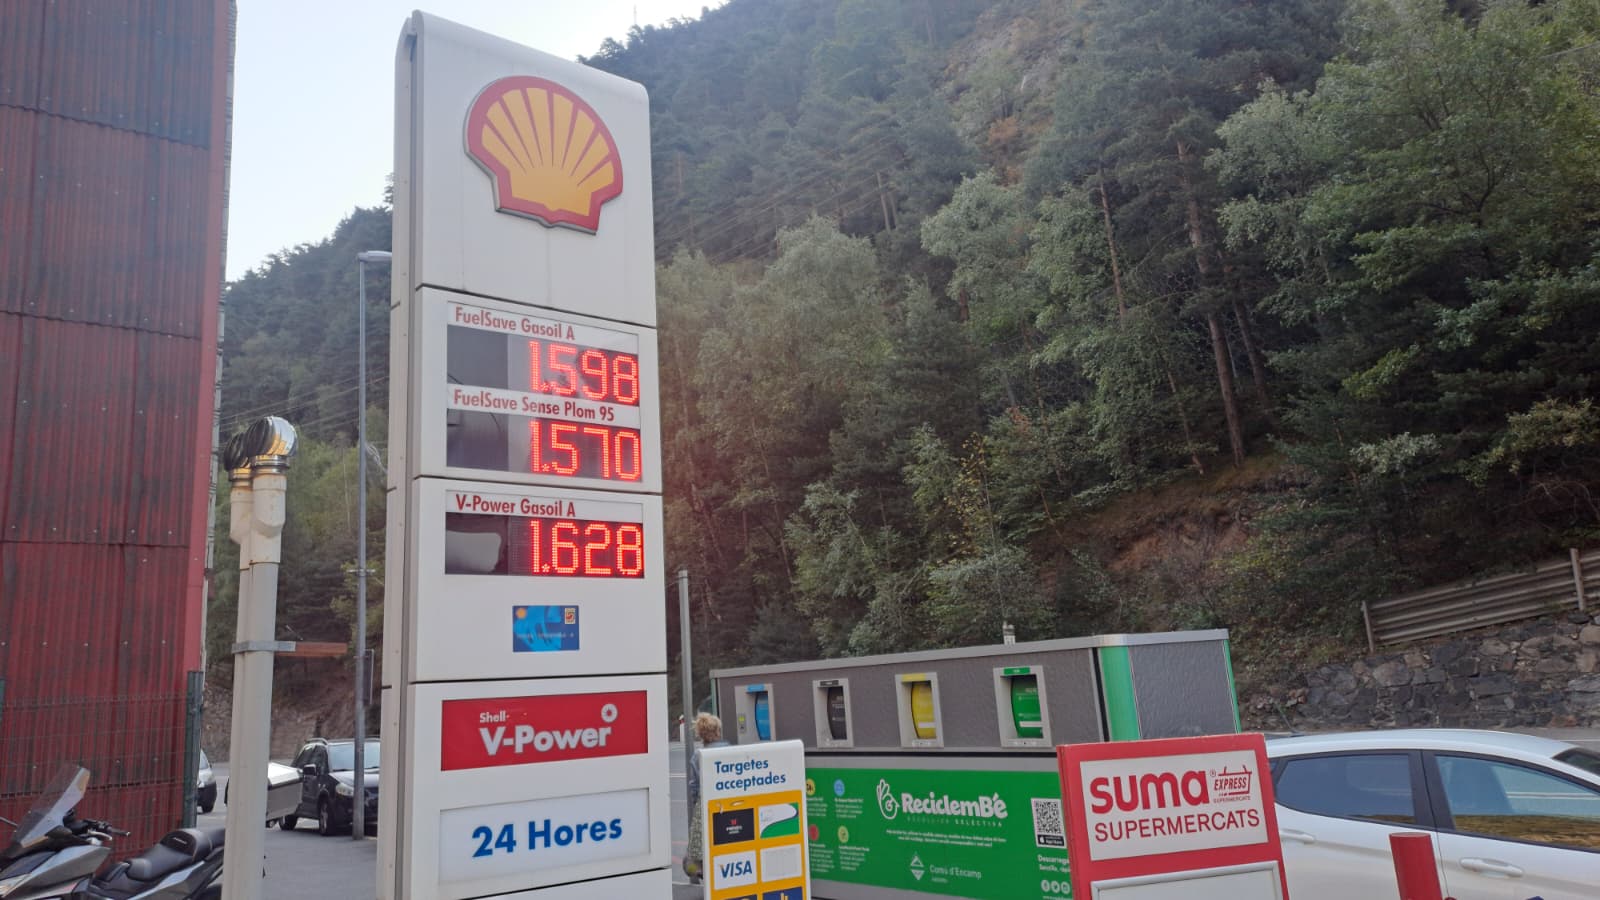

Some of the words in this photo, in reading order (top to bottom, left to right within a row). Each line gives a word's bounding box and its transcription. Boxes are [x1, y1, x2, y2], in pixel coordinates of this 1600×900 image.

[455, 307, 517, 330] FuelSave
[521, 318, 562, 338] Gasoil
[566, 325, 576, 341] A
[529, 340, 639, 404] 1.598
[454, 389, 518, 410] FuelSave
[522, 396, 560, 415] Sense
[564, 403, 596, 420] Plom
[599, 406, 615, 422] 95
[529, 420, 641, 480] 1.570
[455, 494, 516, 514] V-Power
[520, 498, 563, 517] Gasoil
[566, 501, 576, 518] A
[530, 520, 642, 576] 1.628
[479, 710, 506, 723] Shell
[479, 724, 612, 756] V-Power
[714, 759, 769, 776] Targetes
[715, 772, 786, 792] acceptades
[1089, 770, 1210, 814] suma
[1213, 777, 1247, 791] EXPRESS
[901, 791, 1009, 819] ReciclemBé
[472, 823, 517, 858] 24
[528, 818, 623, 850] Hores
[1094, 808, 1260, 843] SUPERMERCATS
[720, 860, 753, 879] VISA
